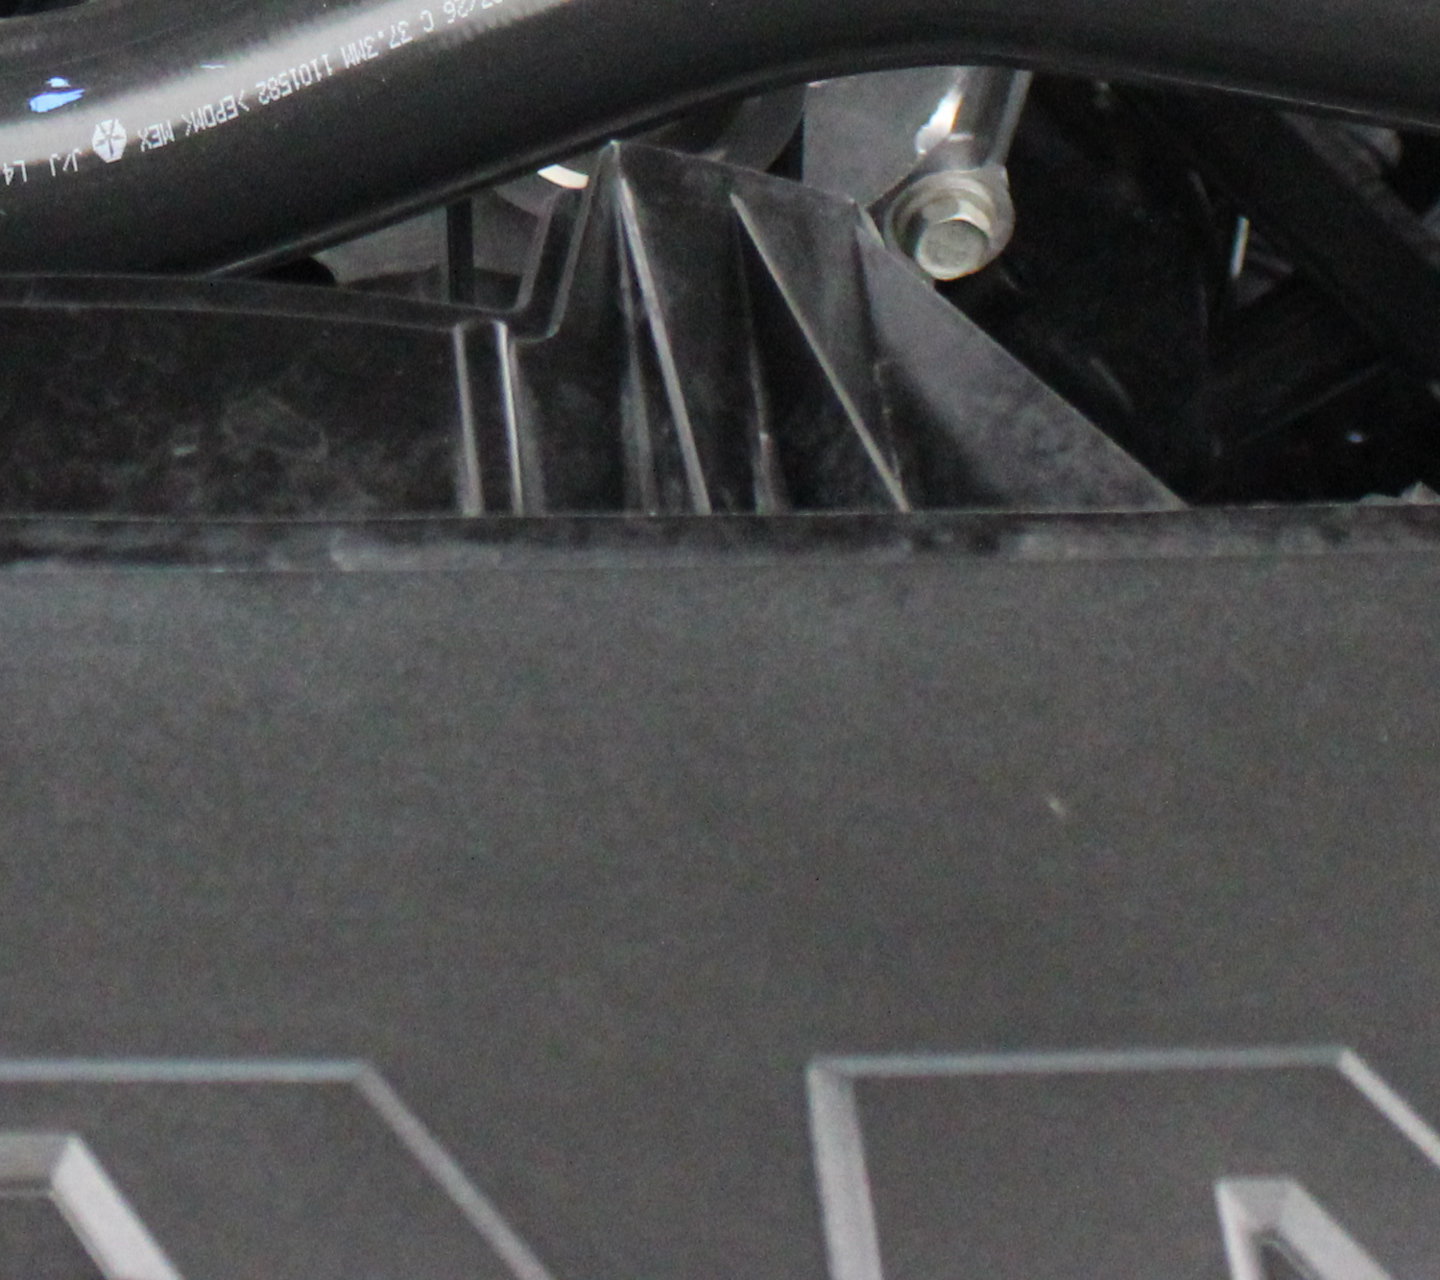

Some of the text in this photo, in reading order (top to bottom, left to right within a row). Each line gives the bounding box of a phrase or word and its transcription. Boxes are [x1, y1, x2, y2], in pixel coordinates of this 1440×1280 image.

[420, 9, 433, 31] C
[342, 18, 412, 68] 37.3MM
[255, 54, 332, 106] 1101582
[138, 119, 175, 152] MEX
[1, 158, 26, 186] L4
